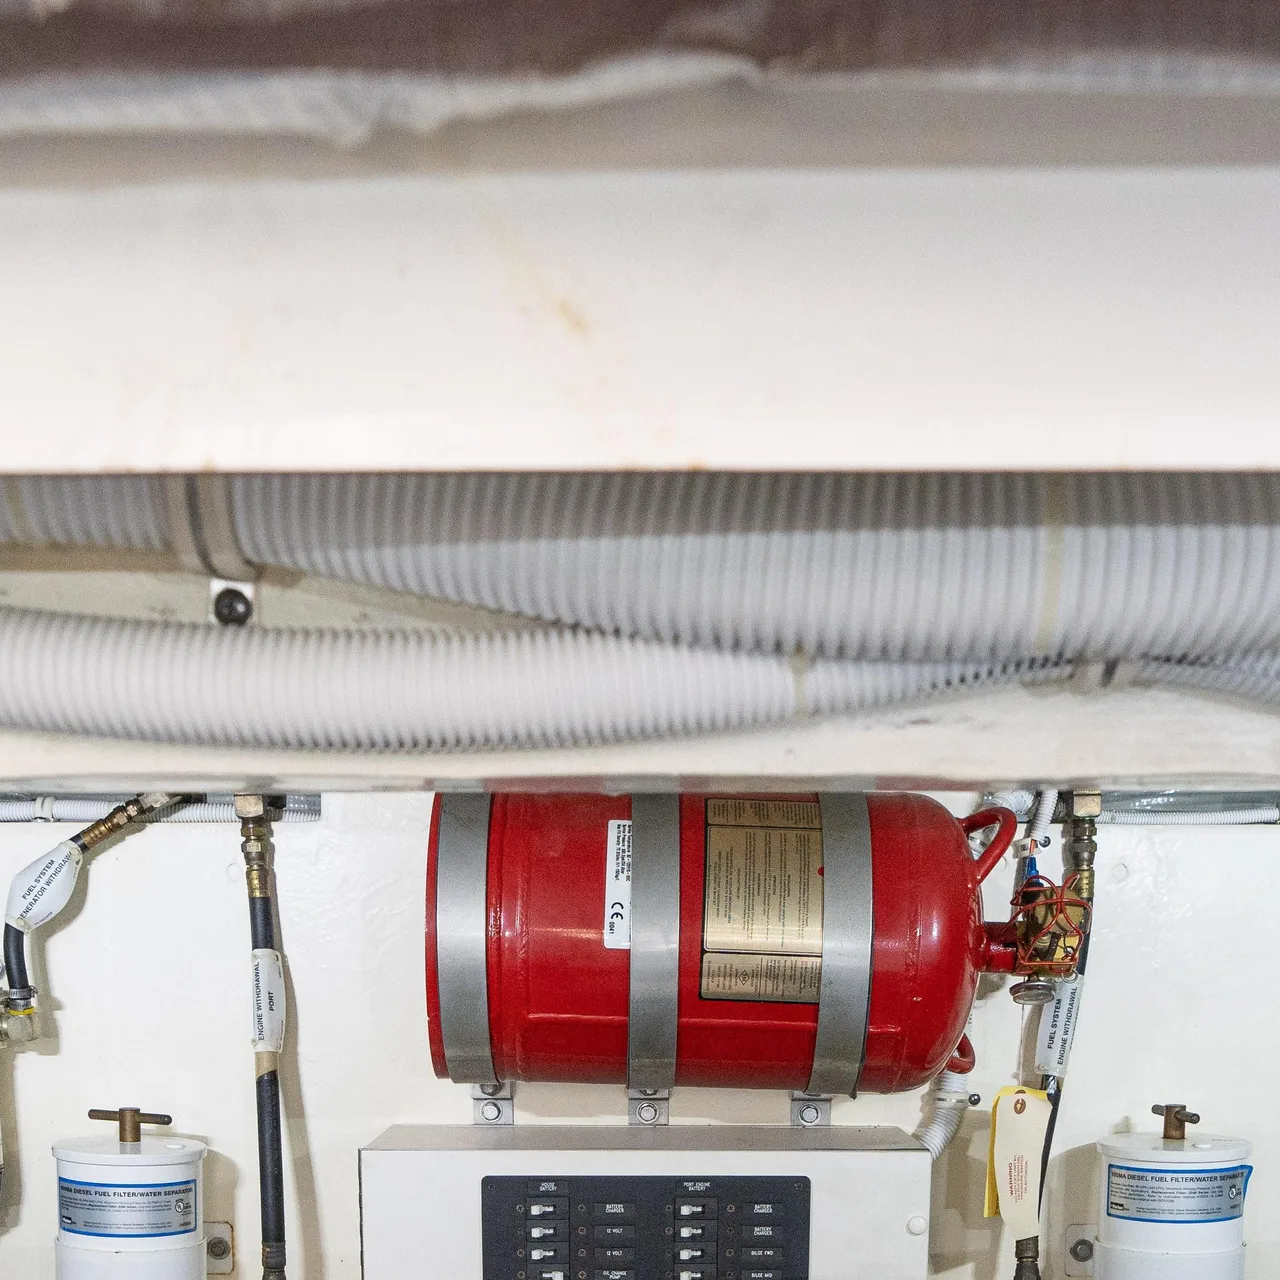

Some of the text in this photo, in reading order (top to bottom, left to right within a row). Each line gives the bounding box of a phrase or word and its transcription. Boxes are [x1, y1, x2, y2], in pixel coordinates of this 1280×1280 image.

[22, 859, 55, 900] FUEL SYSTEM
[256, 1014, 265, 1040] ENGINE
[1047, 998, 1062, 1049] FUEL SYSTEM
[1062, 987, 1077, 1036] WITHDRAWAL
[1057, 1037, 1068, 1065] ENGINE
[1128, 1173, 1150, 1182] DIESEL
